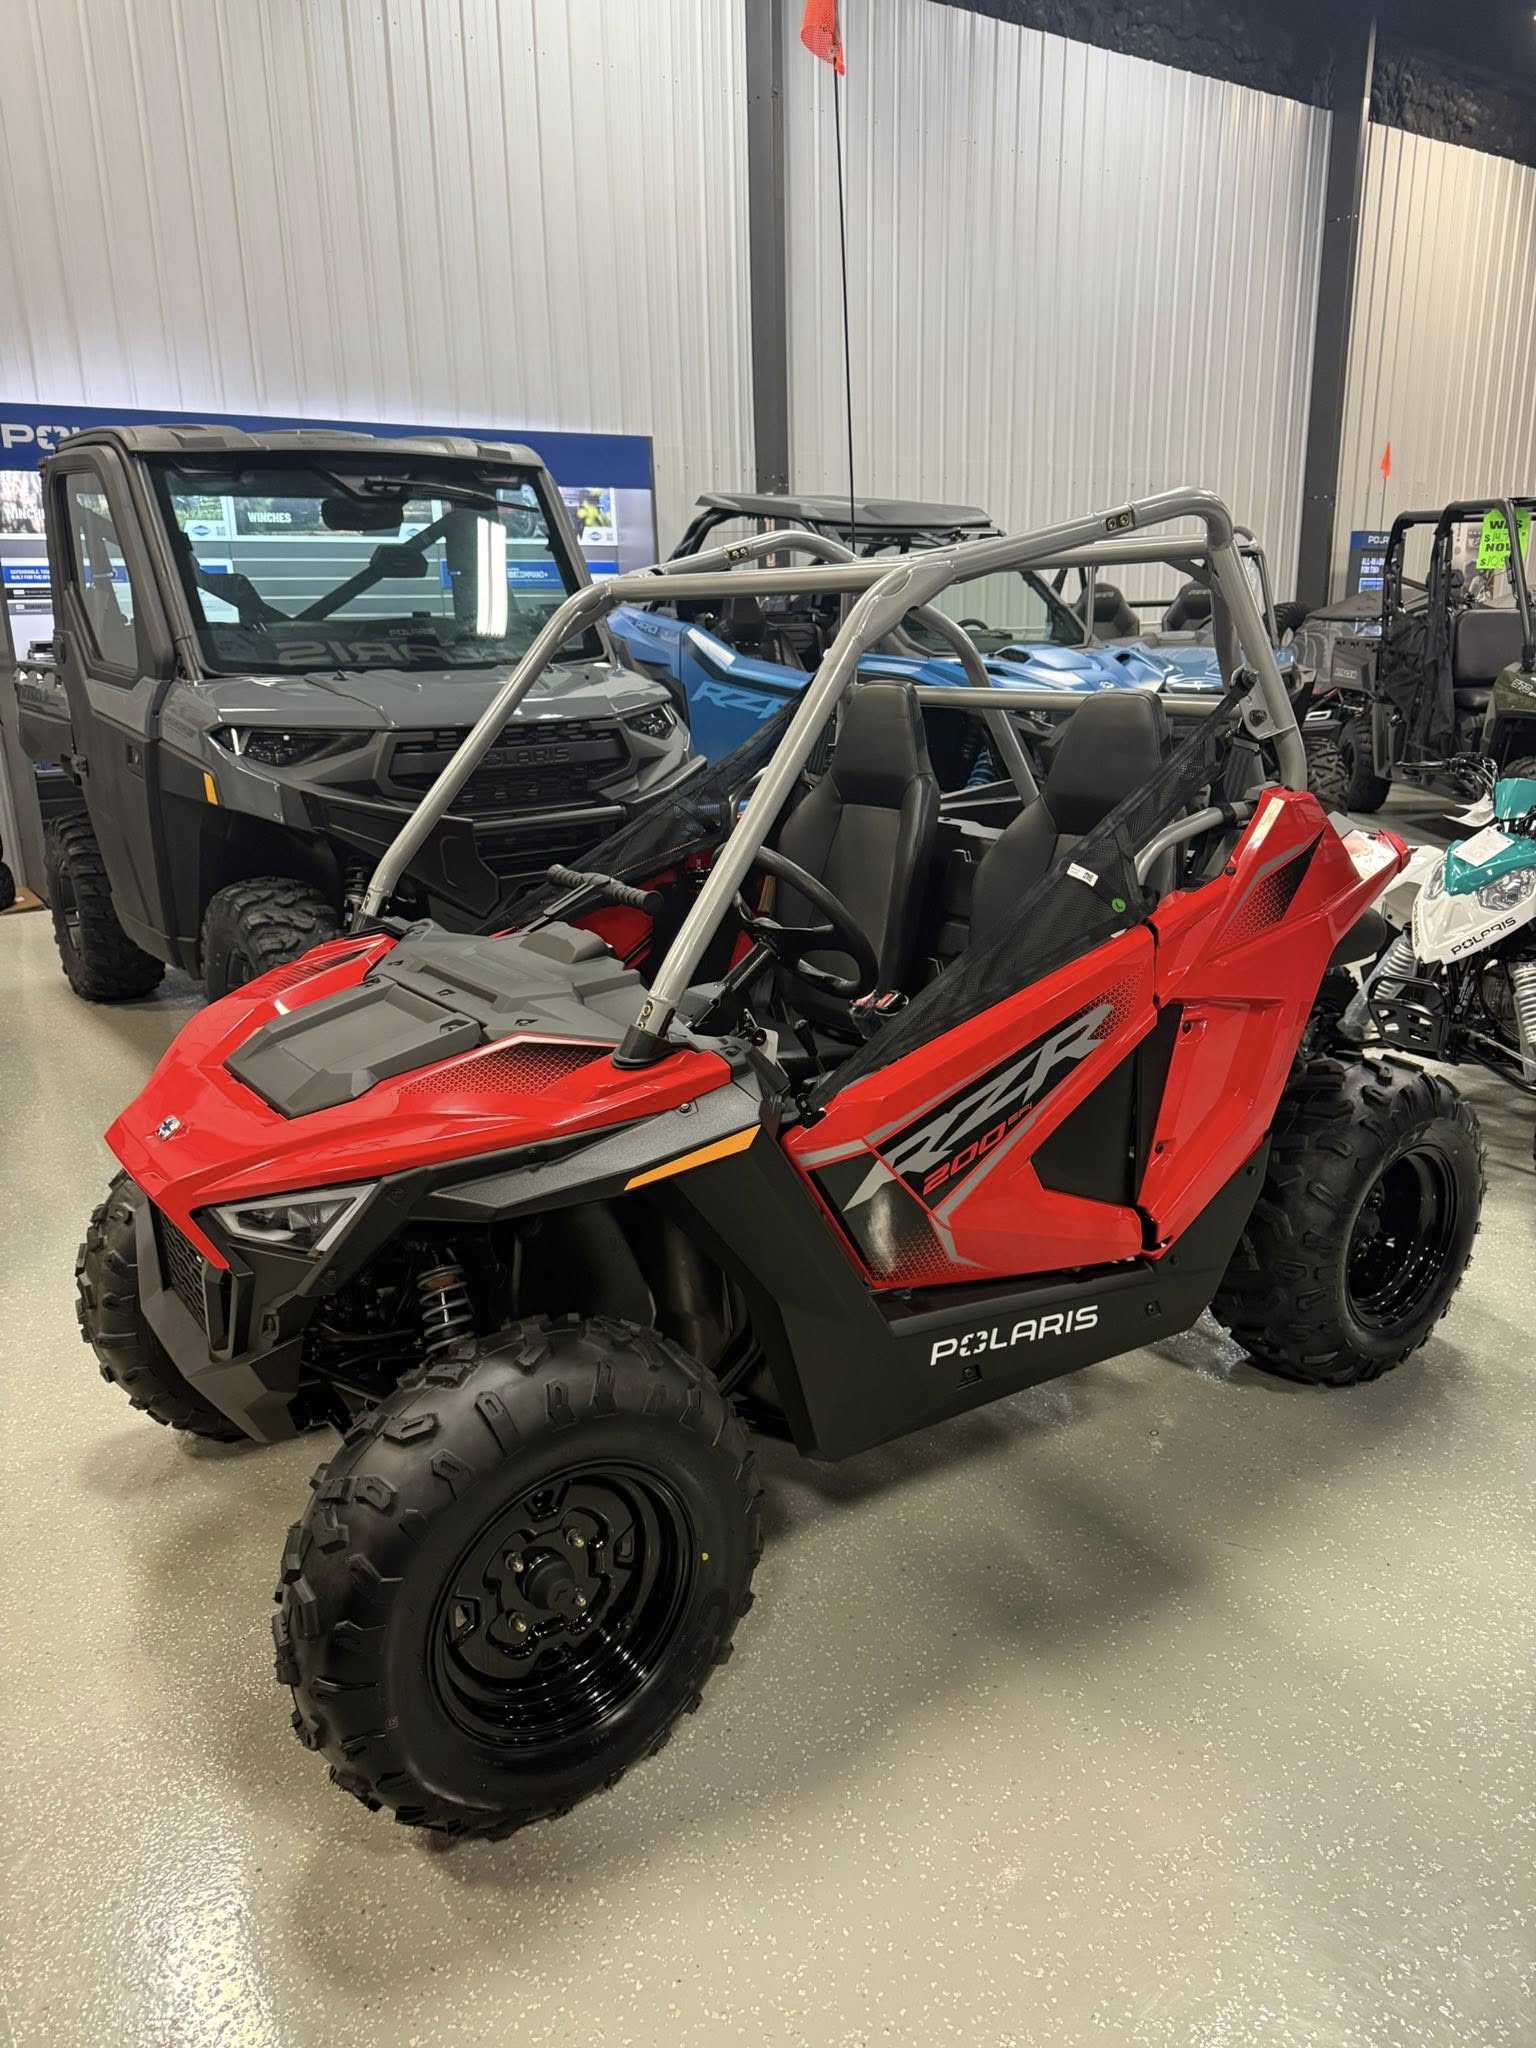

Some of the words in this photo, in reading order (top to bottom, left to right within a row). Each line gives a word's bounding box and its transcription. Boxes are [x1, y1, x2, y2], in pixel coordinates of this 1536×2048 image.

[247, 511, 292, 523] WINCHES
[1368, 535, 1391, 544] POLA
[483, 748, 570, 768] OLARIS
[1451, 916, 1517, 955] POLARIS
[842, 1003, 1114, 1212] RZR
[923, 1121, 1007, 1196] 200
[930, 1305, 1098, 1366] POLARIS
